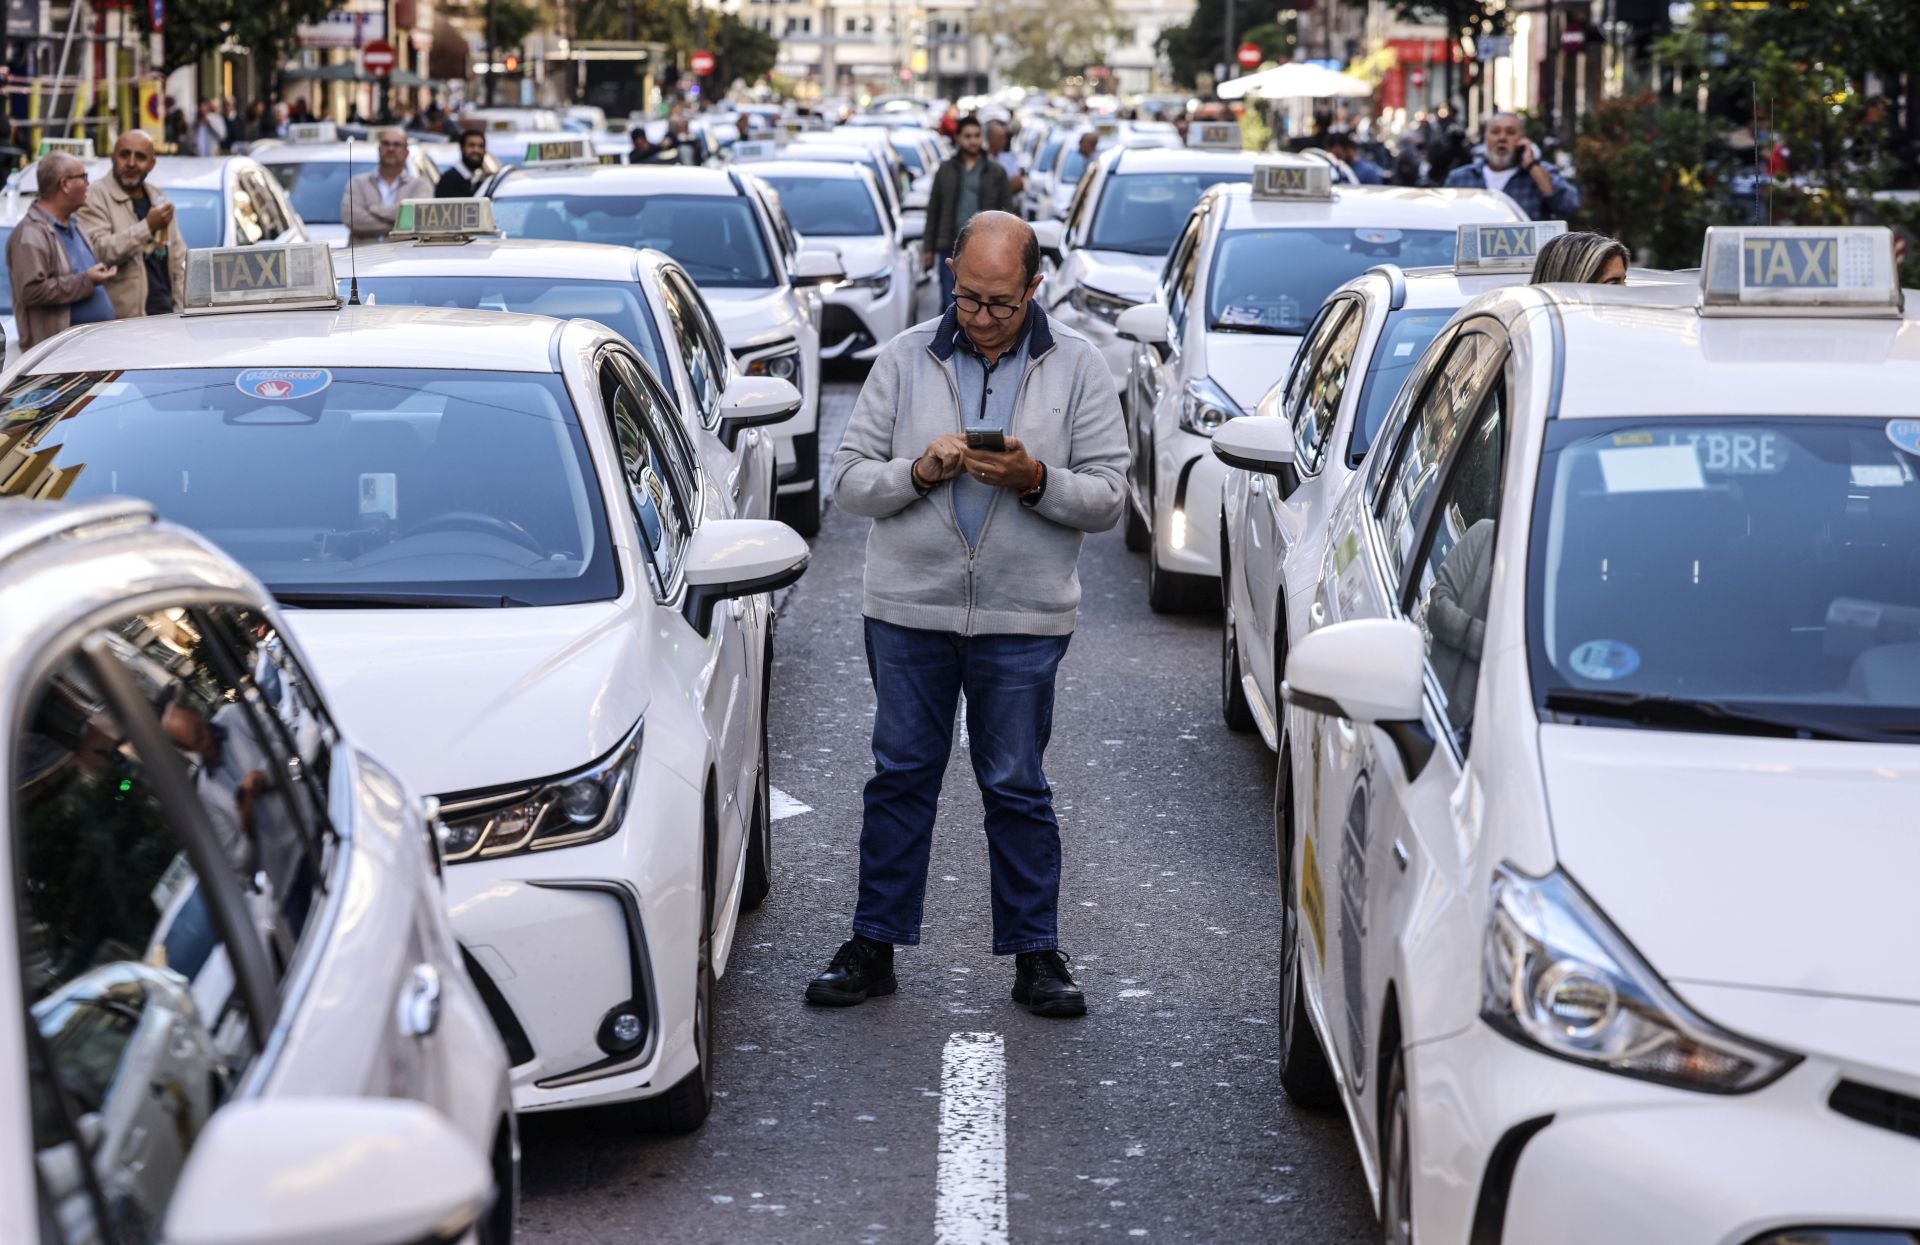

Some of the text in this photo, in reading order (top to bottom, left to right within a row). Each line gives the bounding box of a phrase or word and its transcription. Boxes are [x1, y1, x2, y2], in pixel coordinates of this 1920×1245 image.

[418, 204, 460, 228] TAXI
[1481, 228, 1537, 256] TAXI
[213, 251, 287, 290] TAXI
[1745, 239, 1838, 286] TAXI
